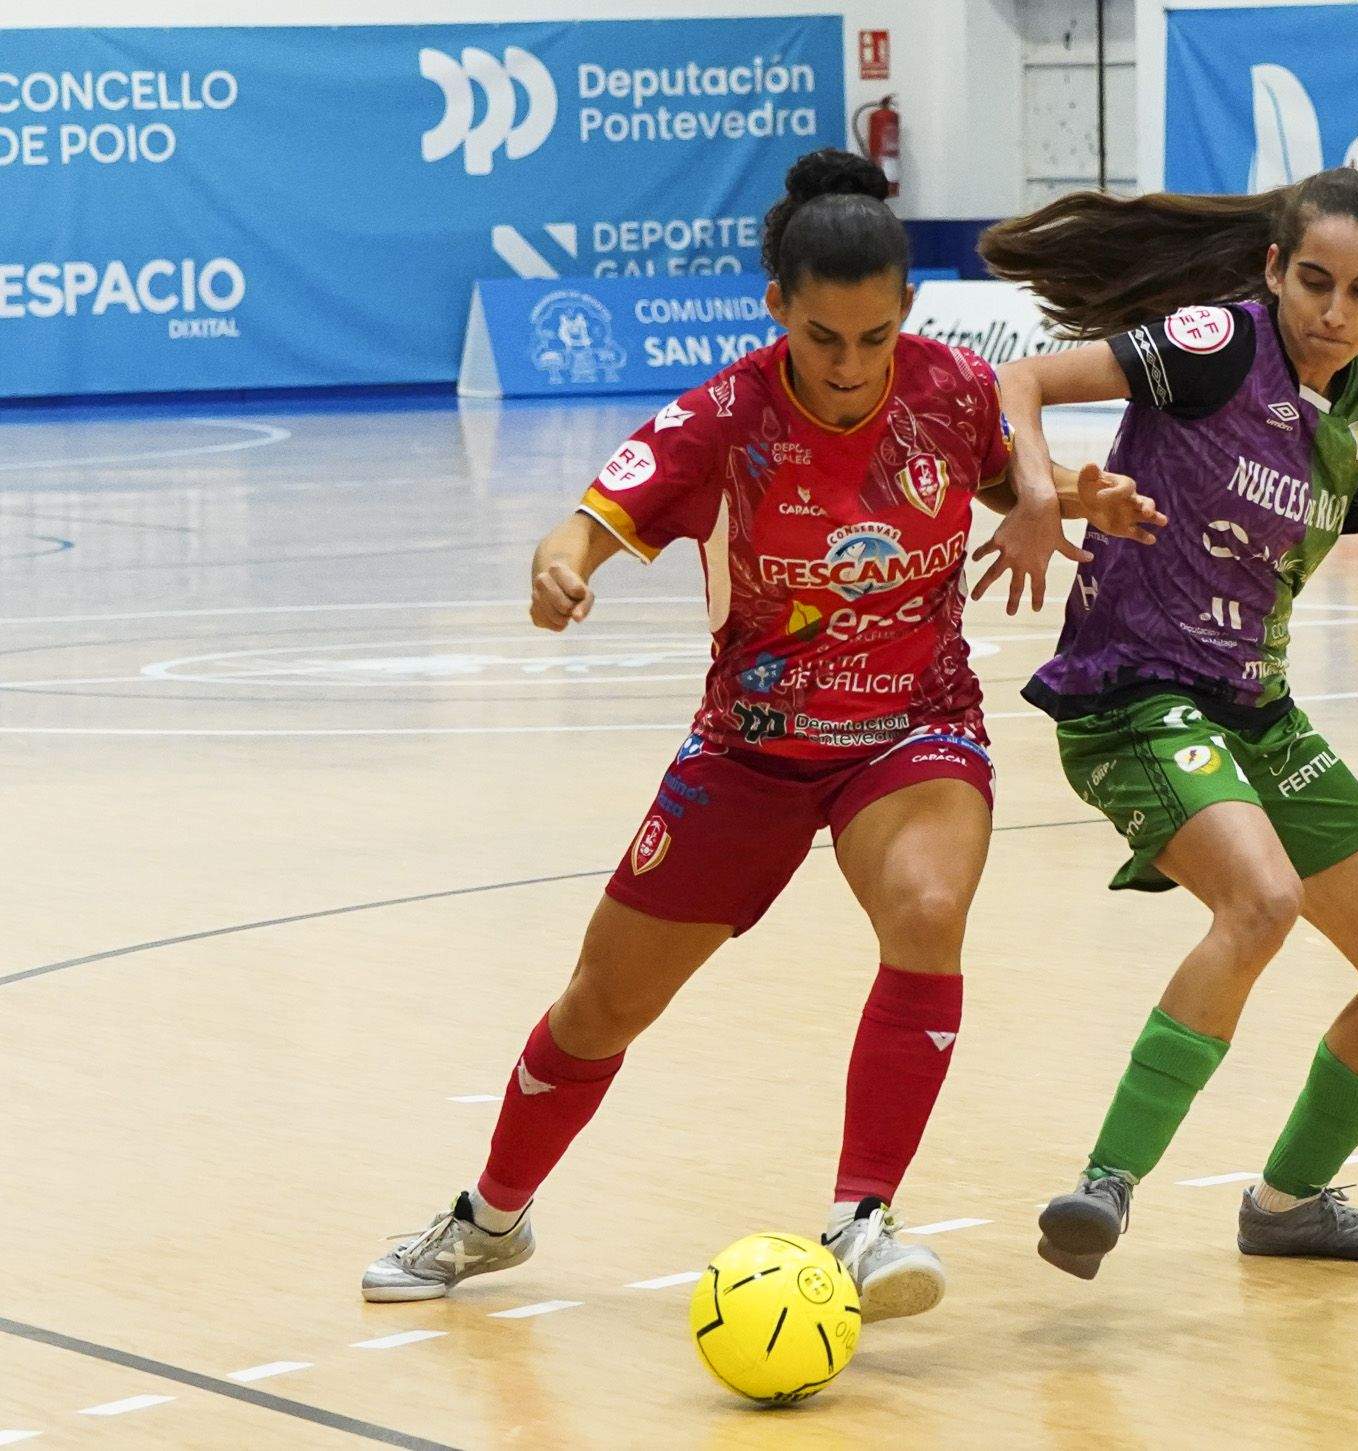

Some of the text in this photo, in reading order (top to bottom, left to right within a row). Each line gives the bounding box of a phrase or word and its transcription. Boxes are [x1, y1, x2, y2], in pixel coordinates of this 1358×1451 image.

[0, 70, 238, 113] CONCELLO
[578, 56, 816, 107] Deputación
[578, 104, 817, 142] Pontevedra
[60, 123, 177, 164] POIO
[593, 216, 759, 252] DEPORTE
[0, 257, 246, 318] ESPACIO
[168, 317, 239, 339] DIXITAL
[644, 335, 712, 367] SAN
[1266, 418, 1294, 432] umbro
[1226, 455, 1309, 522] NUECES
[779, 503, 828, 516] CARACA
[828, 523, 901, 545] CONSERVAS
[760, 531, 965, 590] PESCAMAR
[912, 753, 968, 767] CARACAL
